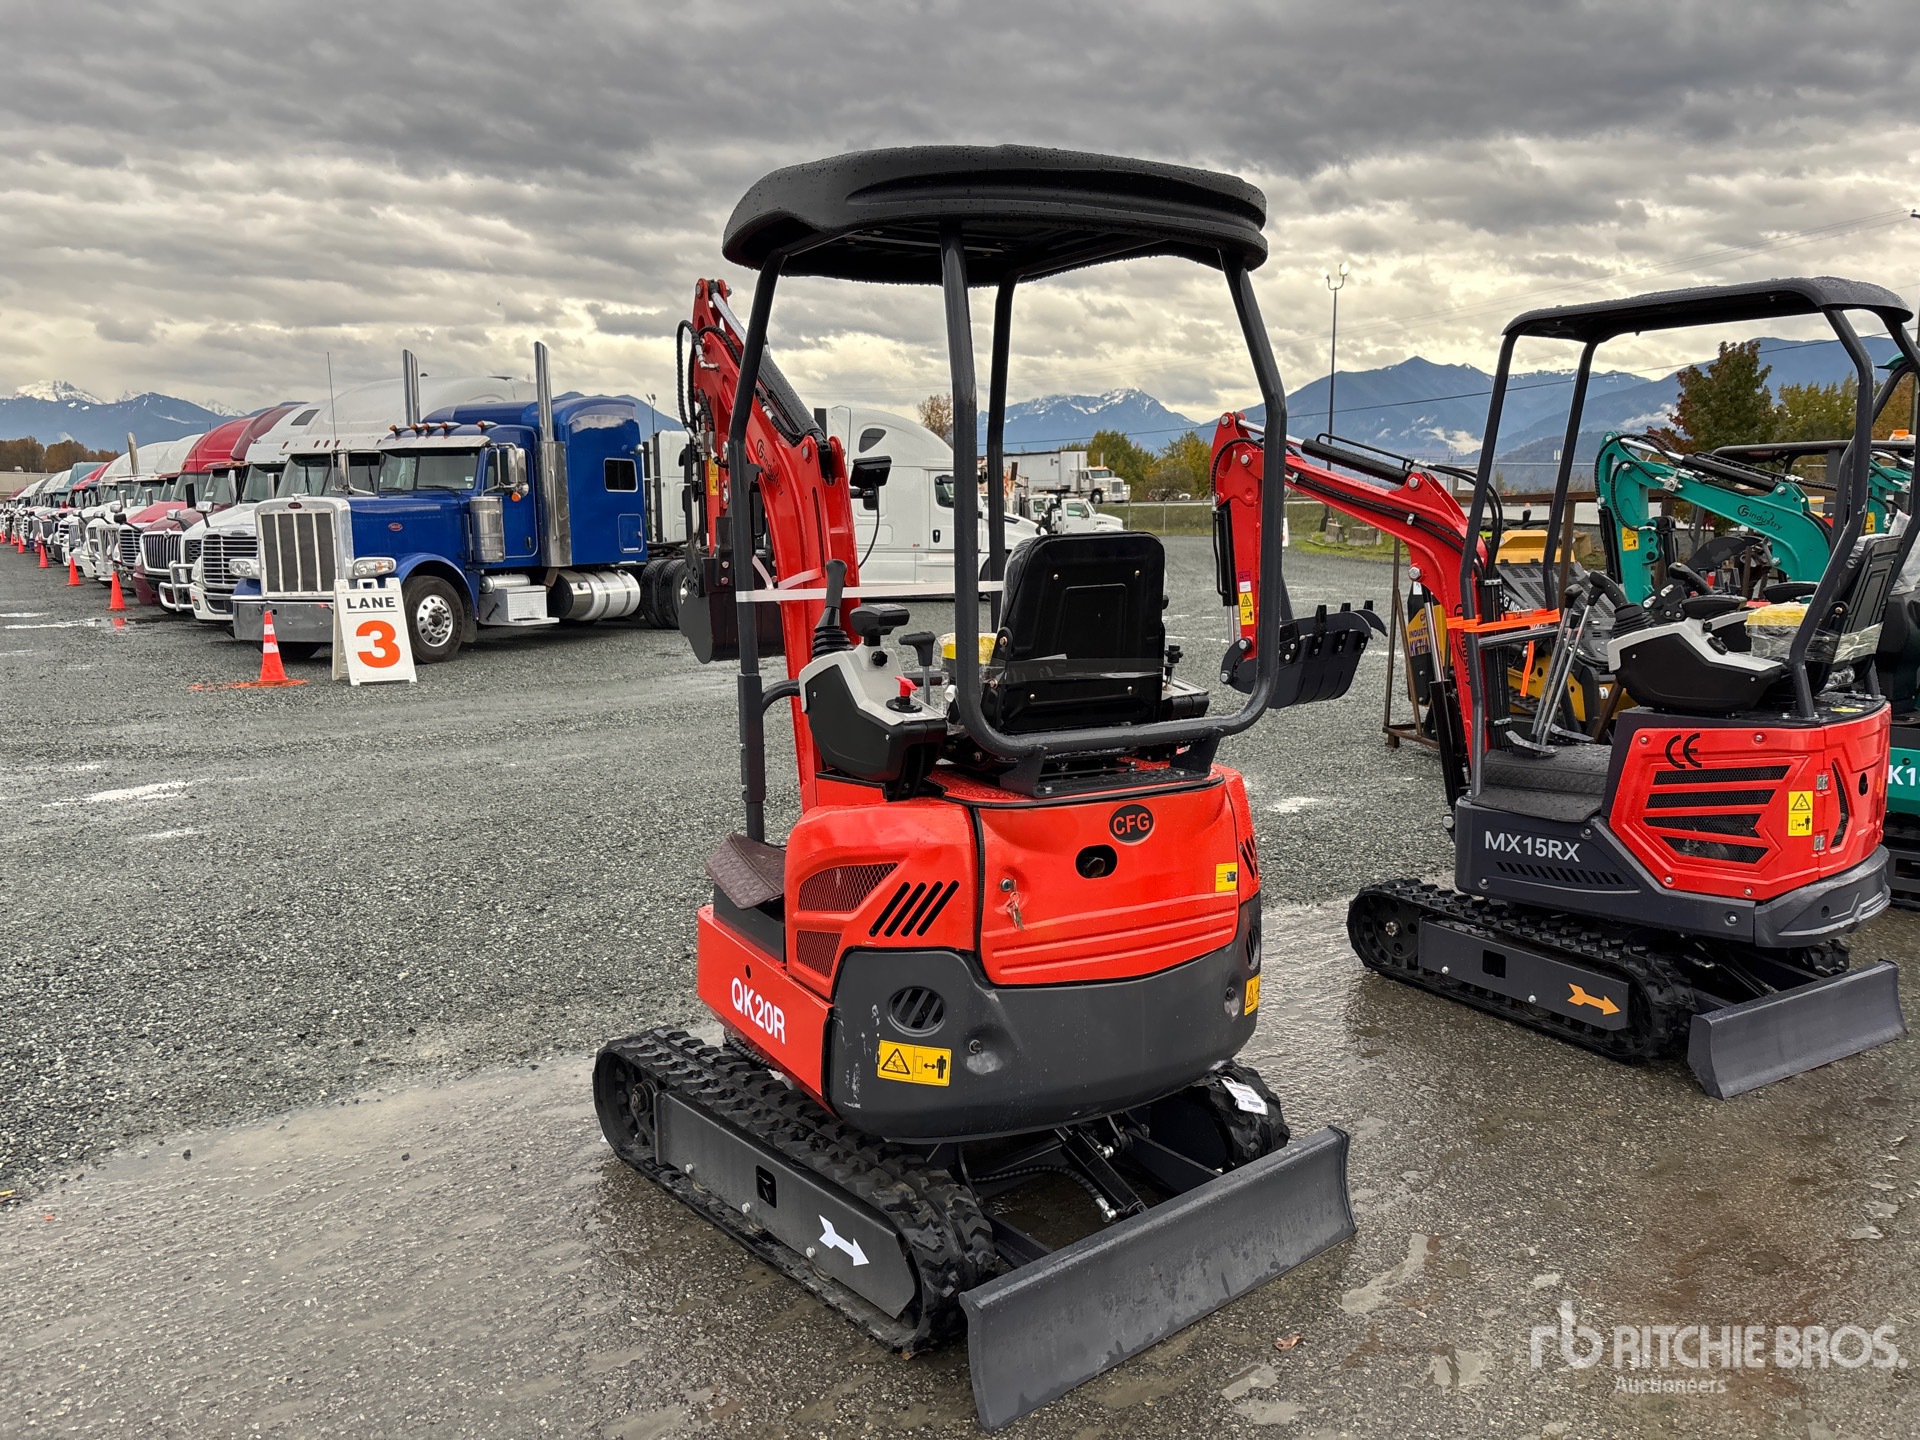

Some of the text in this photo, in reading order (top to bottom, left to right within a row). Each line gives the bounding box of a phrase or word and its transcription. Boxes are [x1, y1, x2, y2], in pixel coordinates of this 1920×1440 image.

[346, 597, 396, 609] LANE
[356, 620, 401, 668] 3
[1888, 764, 1920, 787] K1
[1113, 812, 1150, 835] CFG
[1485, 830, 1581, 863] MX15RX
[731, 977, 786, 1046] QK20R
